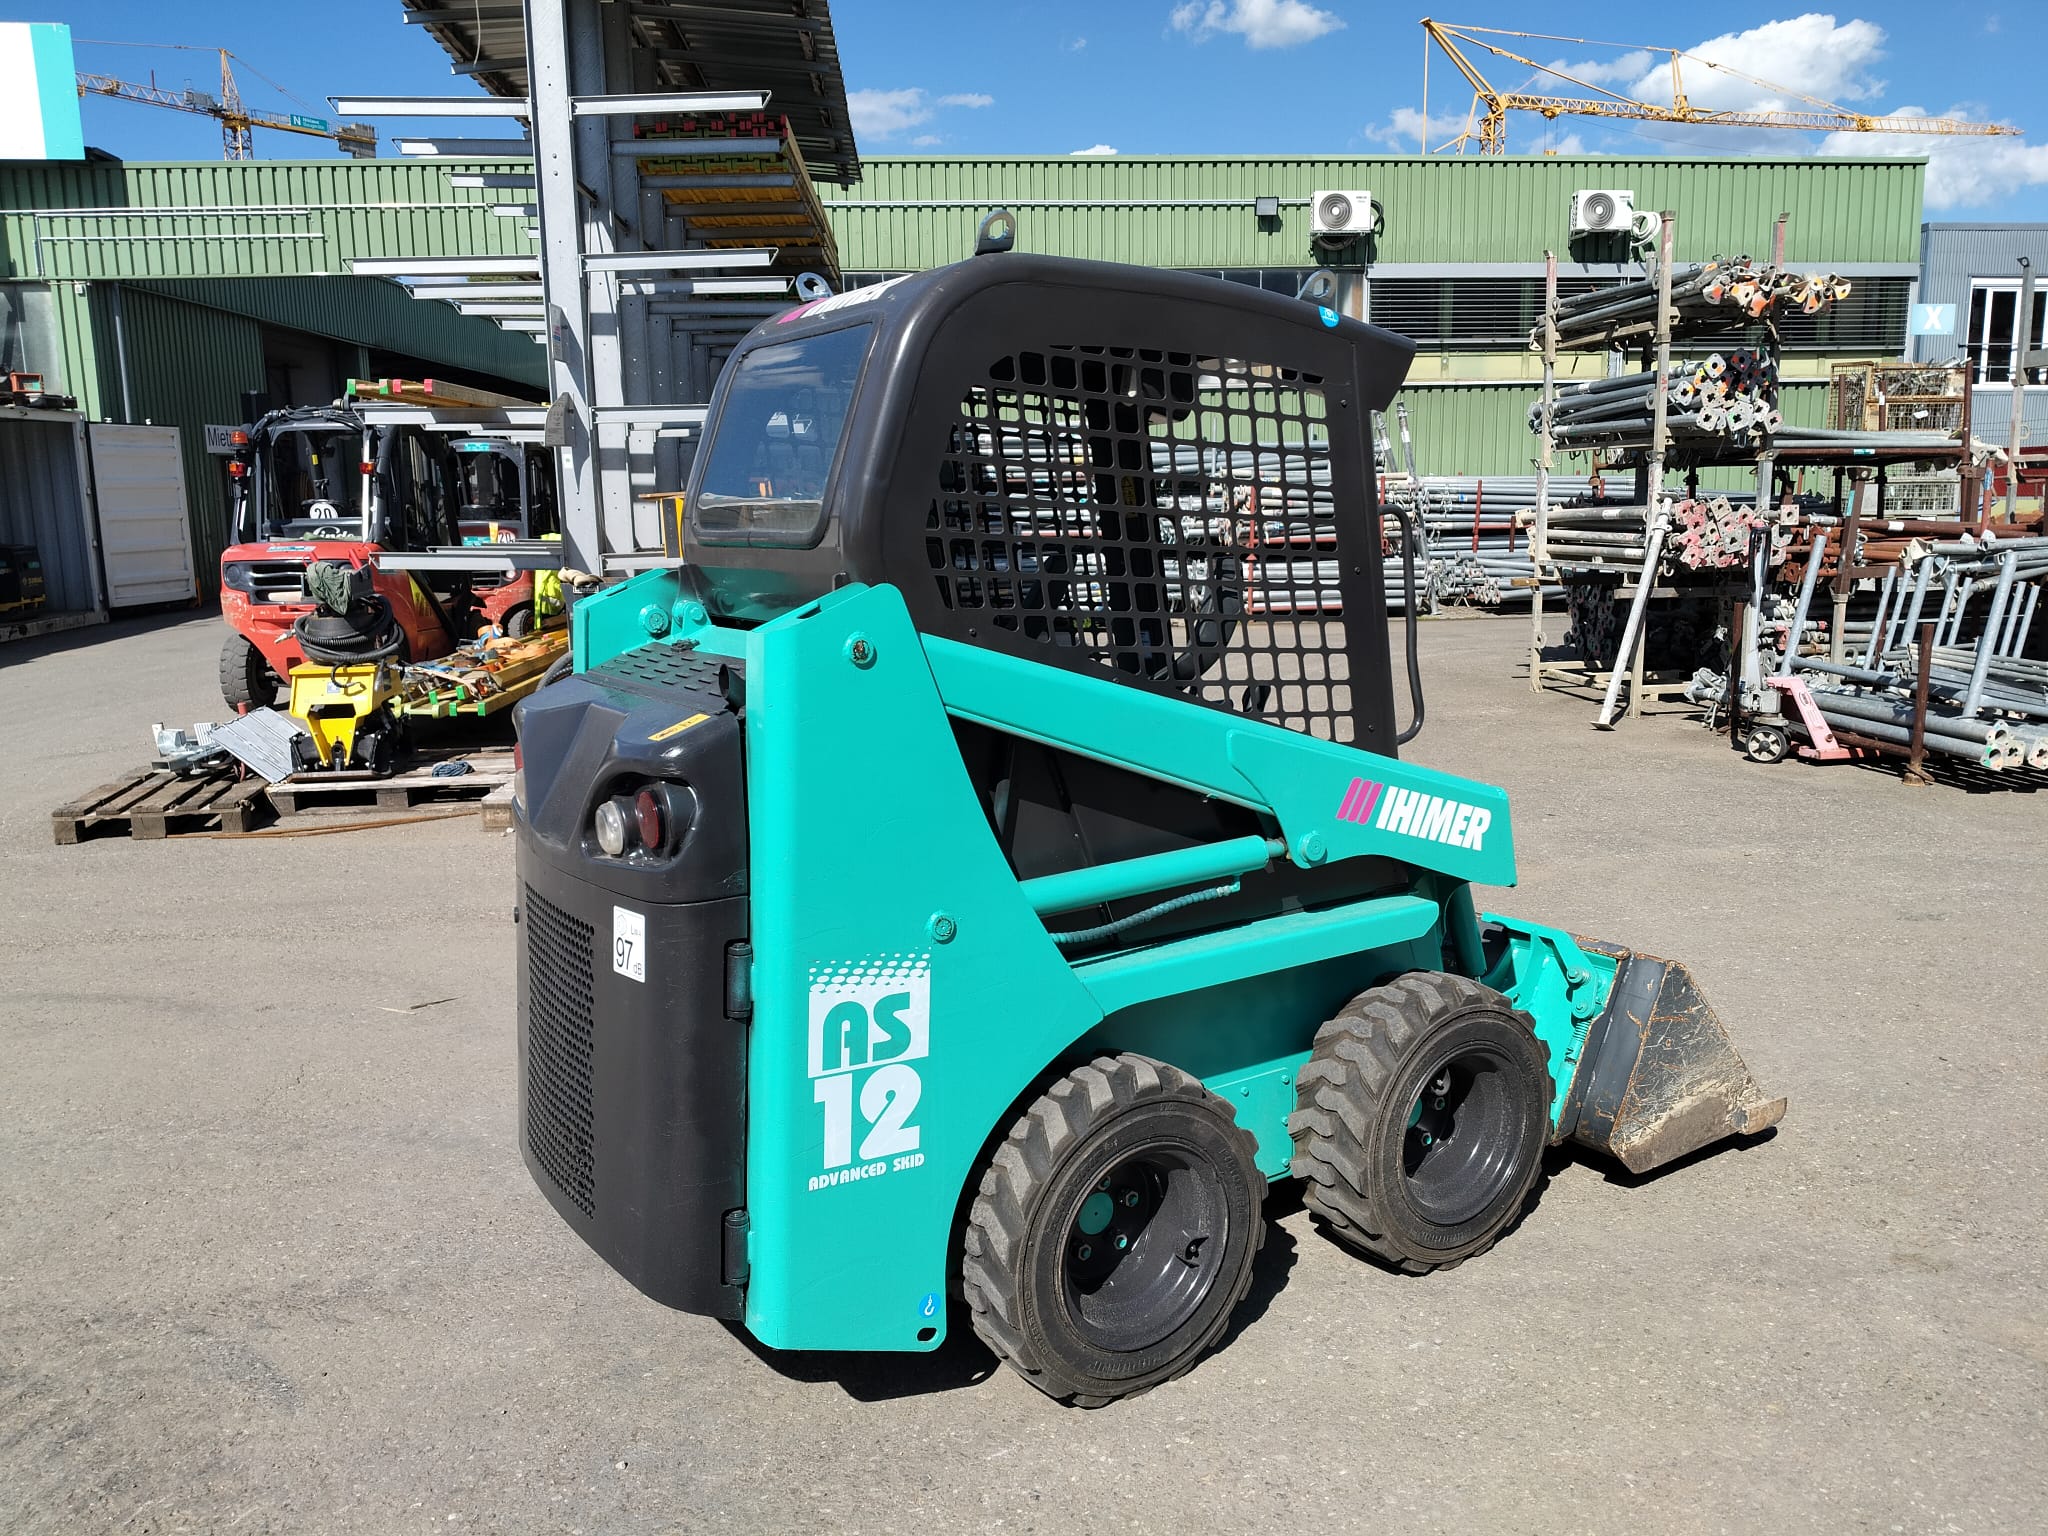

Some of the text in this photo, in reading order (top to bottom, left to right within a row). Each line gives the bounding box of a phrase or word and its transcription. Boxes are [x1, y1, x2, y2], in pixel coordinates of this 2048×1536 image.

[1923, 305, 1944, 330] X
[207, 426, 233, 448] Miet
[1375, 785, 1492, 851] IHIMER
[616, 937, 633, 970] 97
[822, 991, 911, 1071] AS
[814, 1063, 922, 1169] 12
[808, 1153, 925, 1191] ADVANCED SKID
